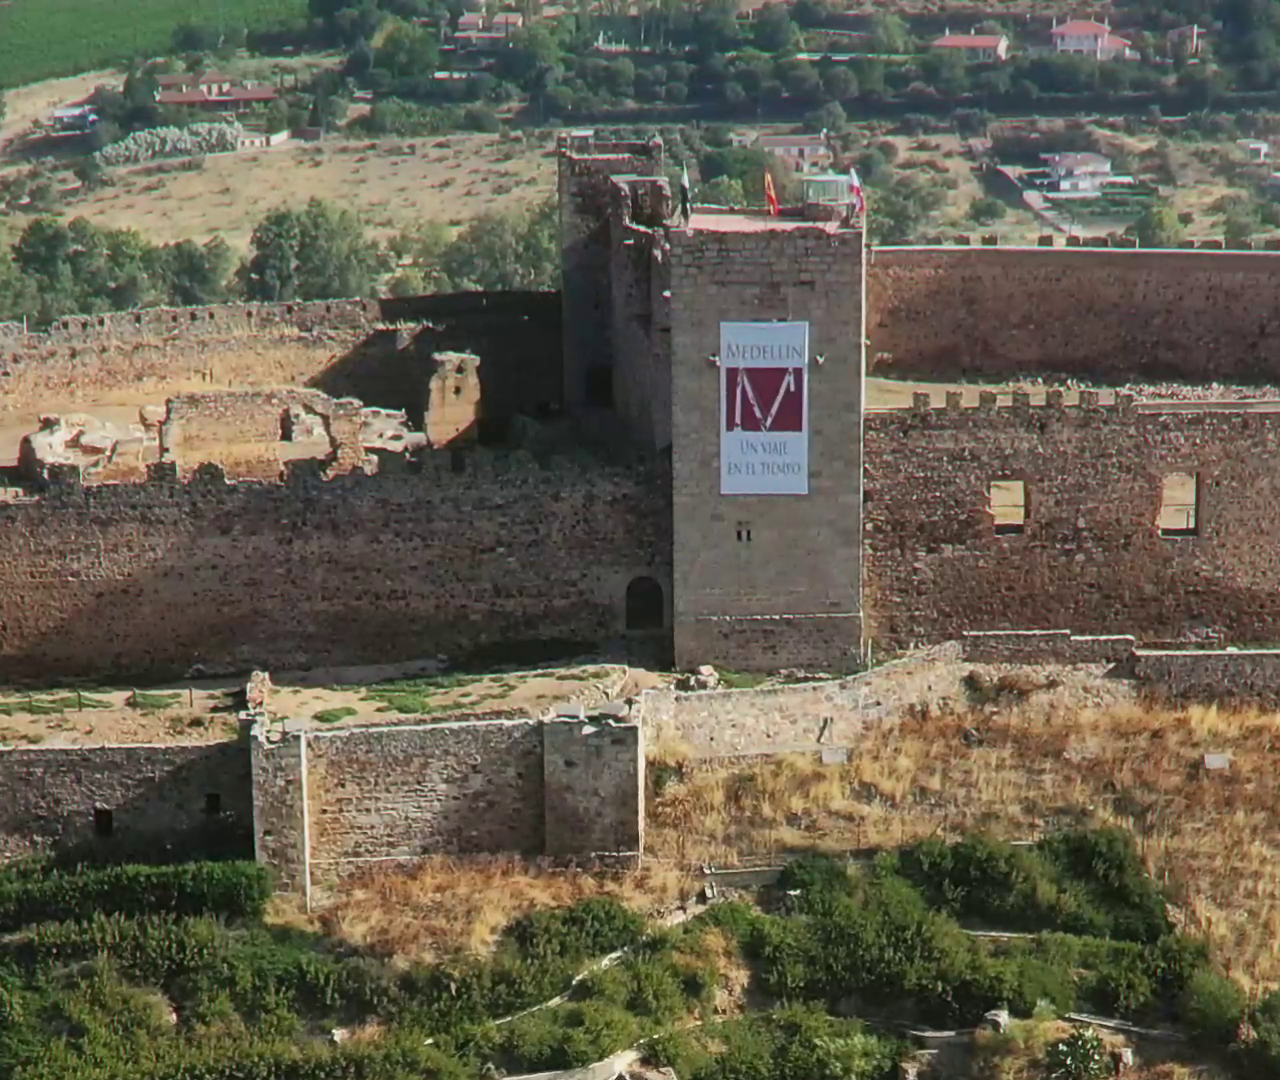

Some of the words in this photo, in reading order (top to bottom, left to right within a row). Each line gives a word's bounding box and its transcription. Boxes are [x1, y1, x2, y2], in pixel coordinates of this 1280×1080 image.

[740, 439, 758, 455] UN
[760, 441, 789, 456] VIAJE
[727, 462, 743, 476] EN
[746, 462, 756, 476] EL
[760, 462, 801, 476] TIEMPO
